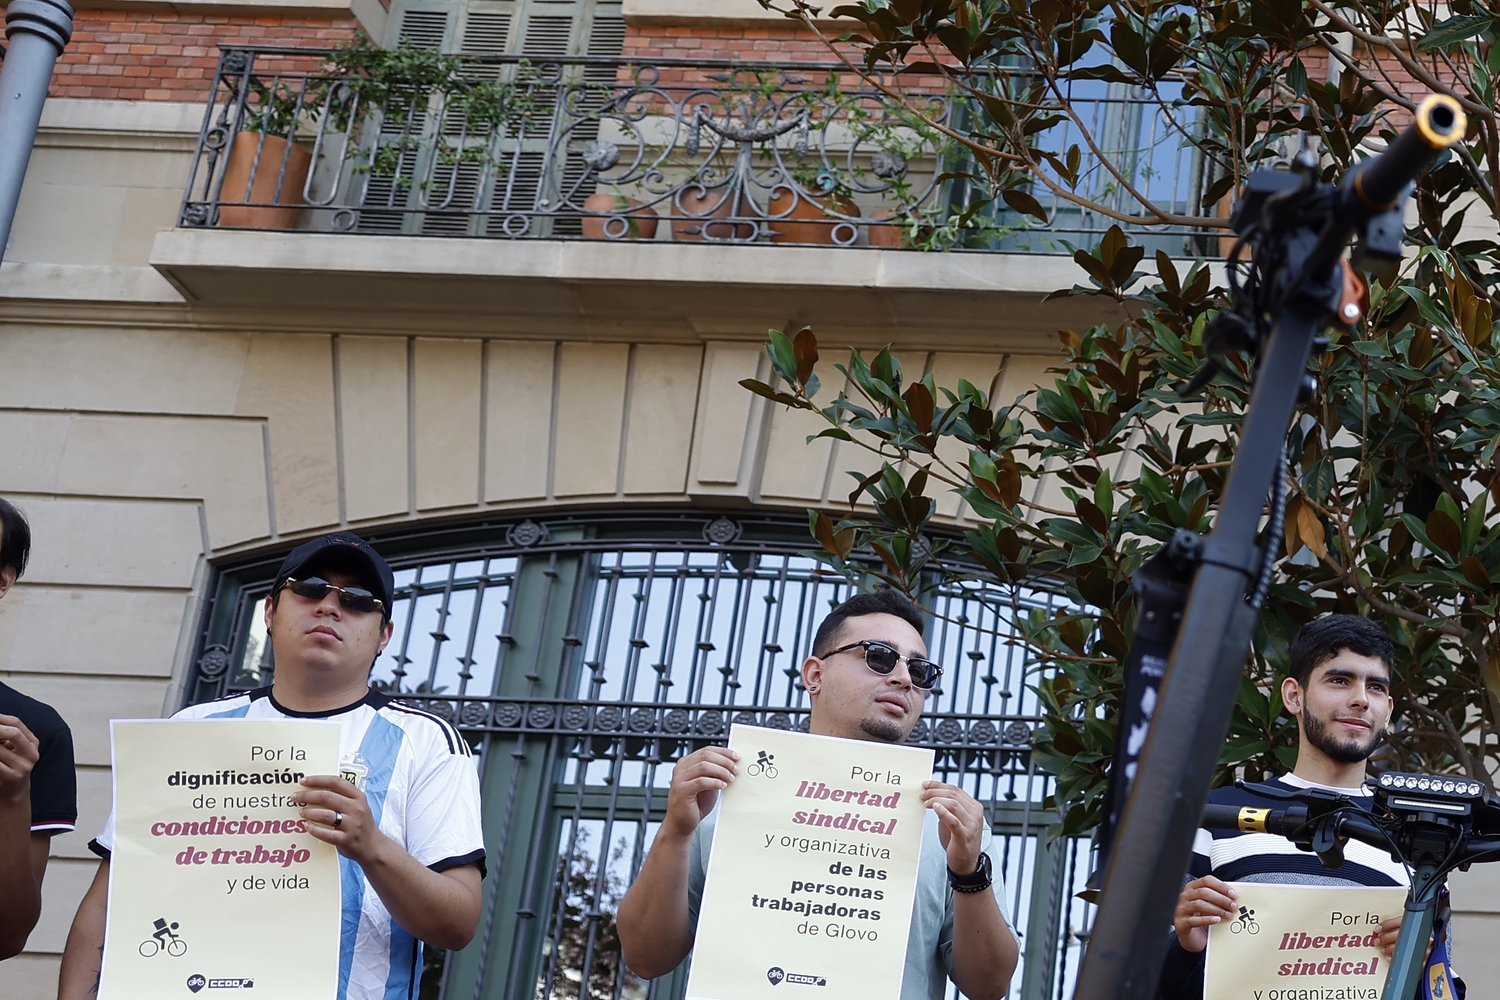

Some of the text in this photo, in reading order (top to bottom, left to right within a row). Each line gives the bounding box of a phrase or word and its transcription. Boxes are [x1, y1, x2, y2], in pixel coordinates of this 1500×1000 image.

[251, 746, 306, 761] Por la
[168, 768, 305, 789] dignificación
[851, 766, 901, 786] Por la
[193, 794, 216, 809] de
[795, 780, 901, 809] libertad
[151, 816, 308, 837] condiciones
[792, 808, 897, 836] sindical
[175, 844, 310, 868] de trabajo
[764, 833, 890, 860] y organizativa
[829, 861, 887, 880] de las
[227, 875, 309, 894] y de vida
[791, 879, 884, 900] personas
[752, 894, 881, 921] trabajadoras
[1331, 912, 1379, 926] Por la
[797, 921, 878, 942] de Glovo
[1278, 931, 1379, 950] libertad
[1278, 957, 1379, 977] sindical
